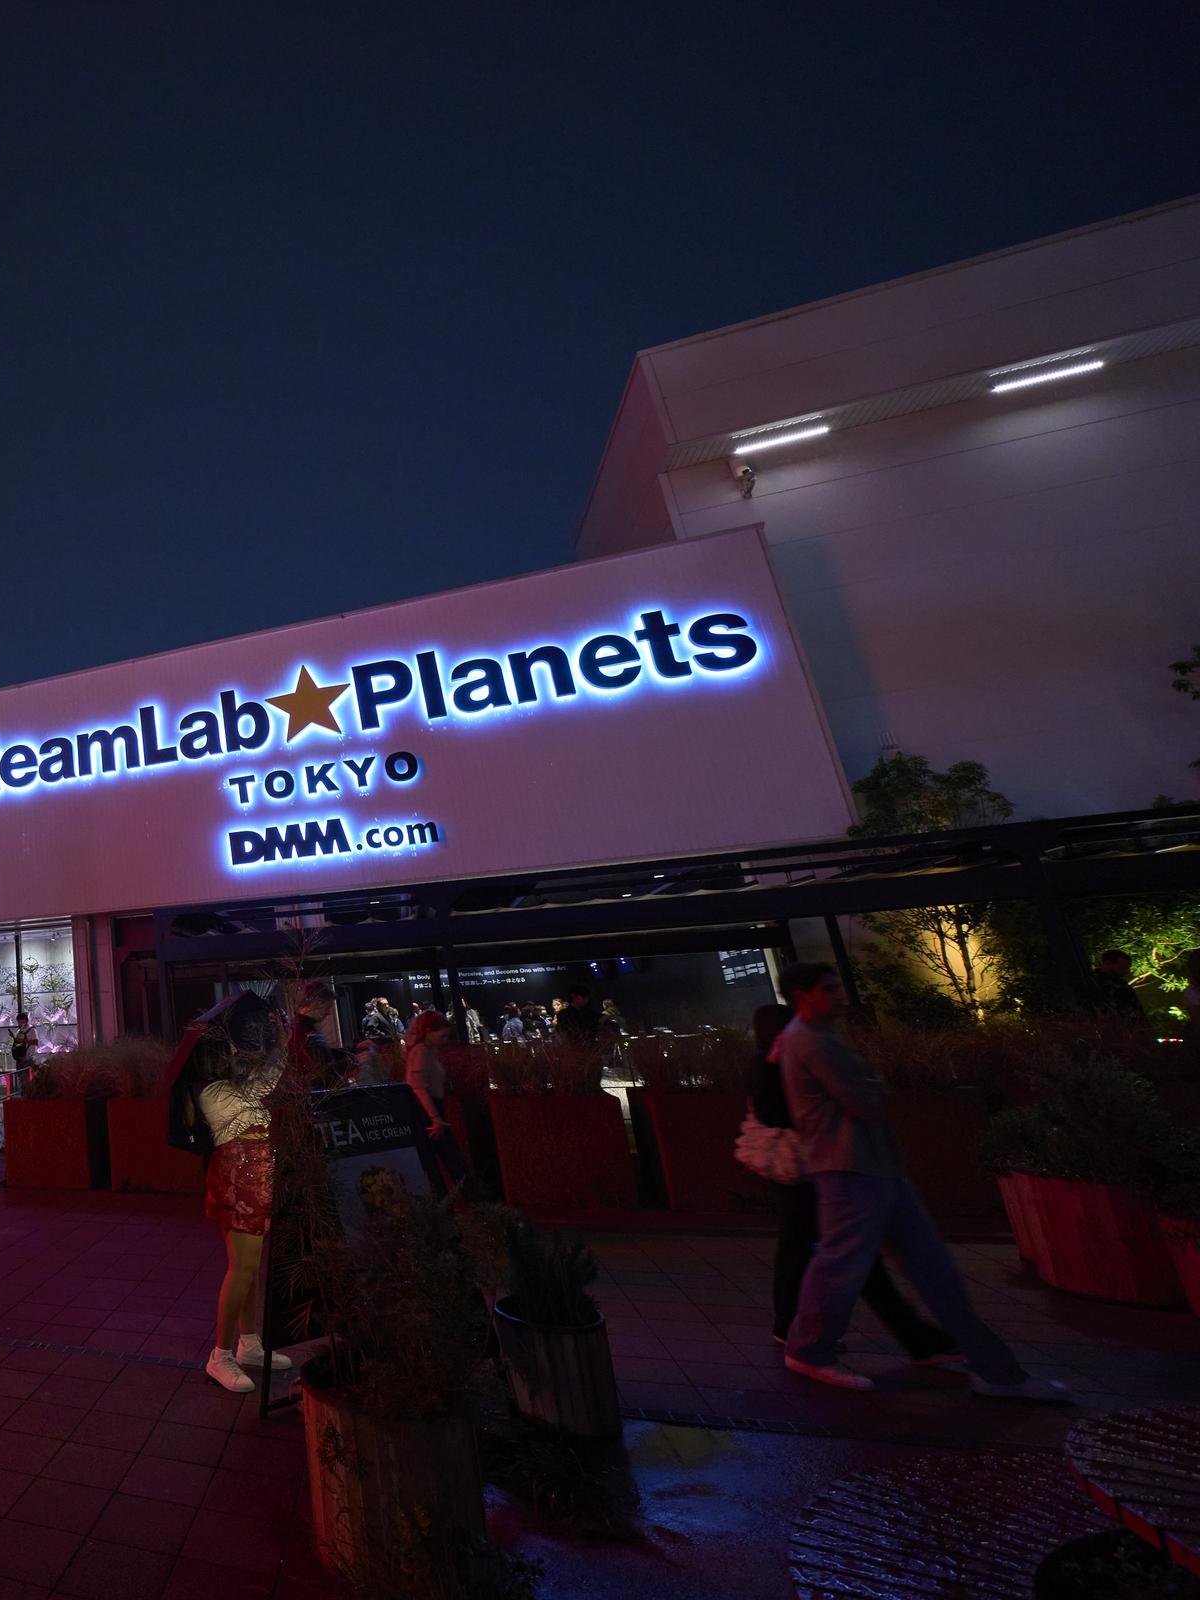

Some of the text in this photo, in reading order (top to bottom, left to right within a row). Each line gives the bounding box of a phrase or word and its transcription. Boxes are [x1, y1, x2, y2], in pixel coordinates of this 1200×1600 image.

[352, 610, 757, 730] Planets
[229, 751, 418, 804] TOKYO
[229, 818, 439, 865] DMM.com
[313, 1113, 394, 1148] TEA MUFFIN
[366, 1125, 412, 1141] ICE CREAM
